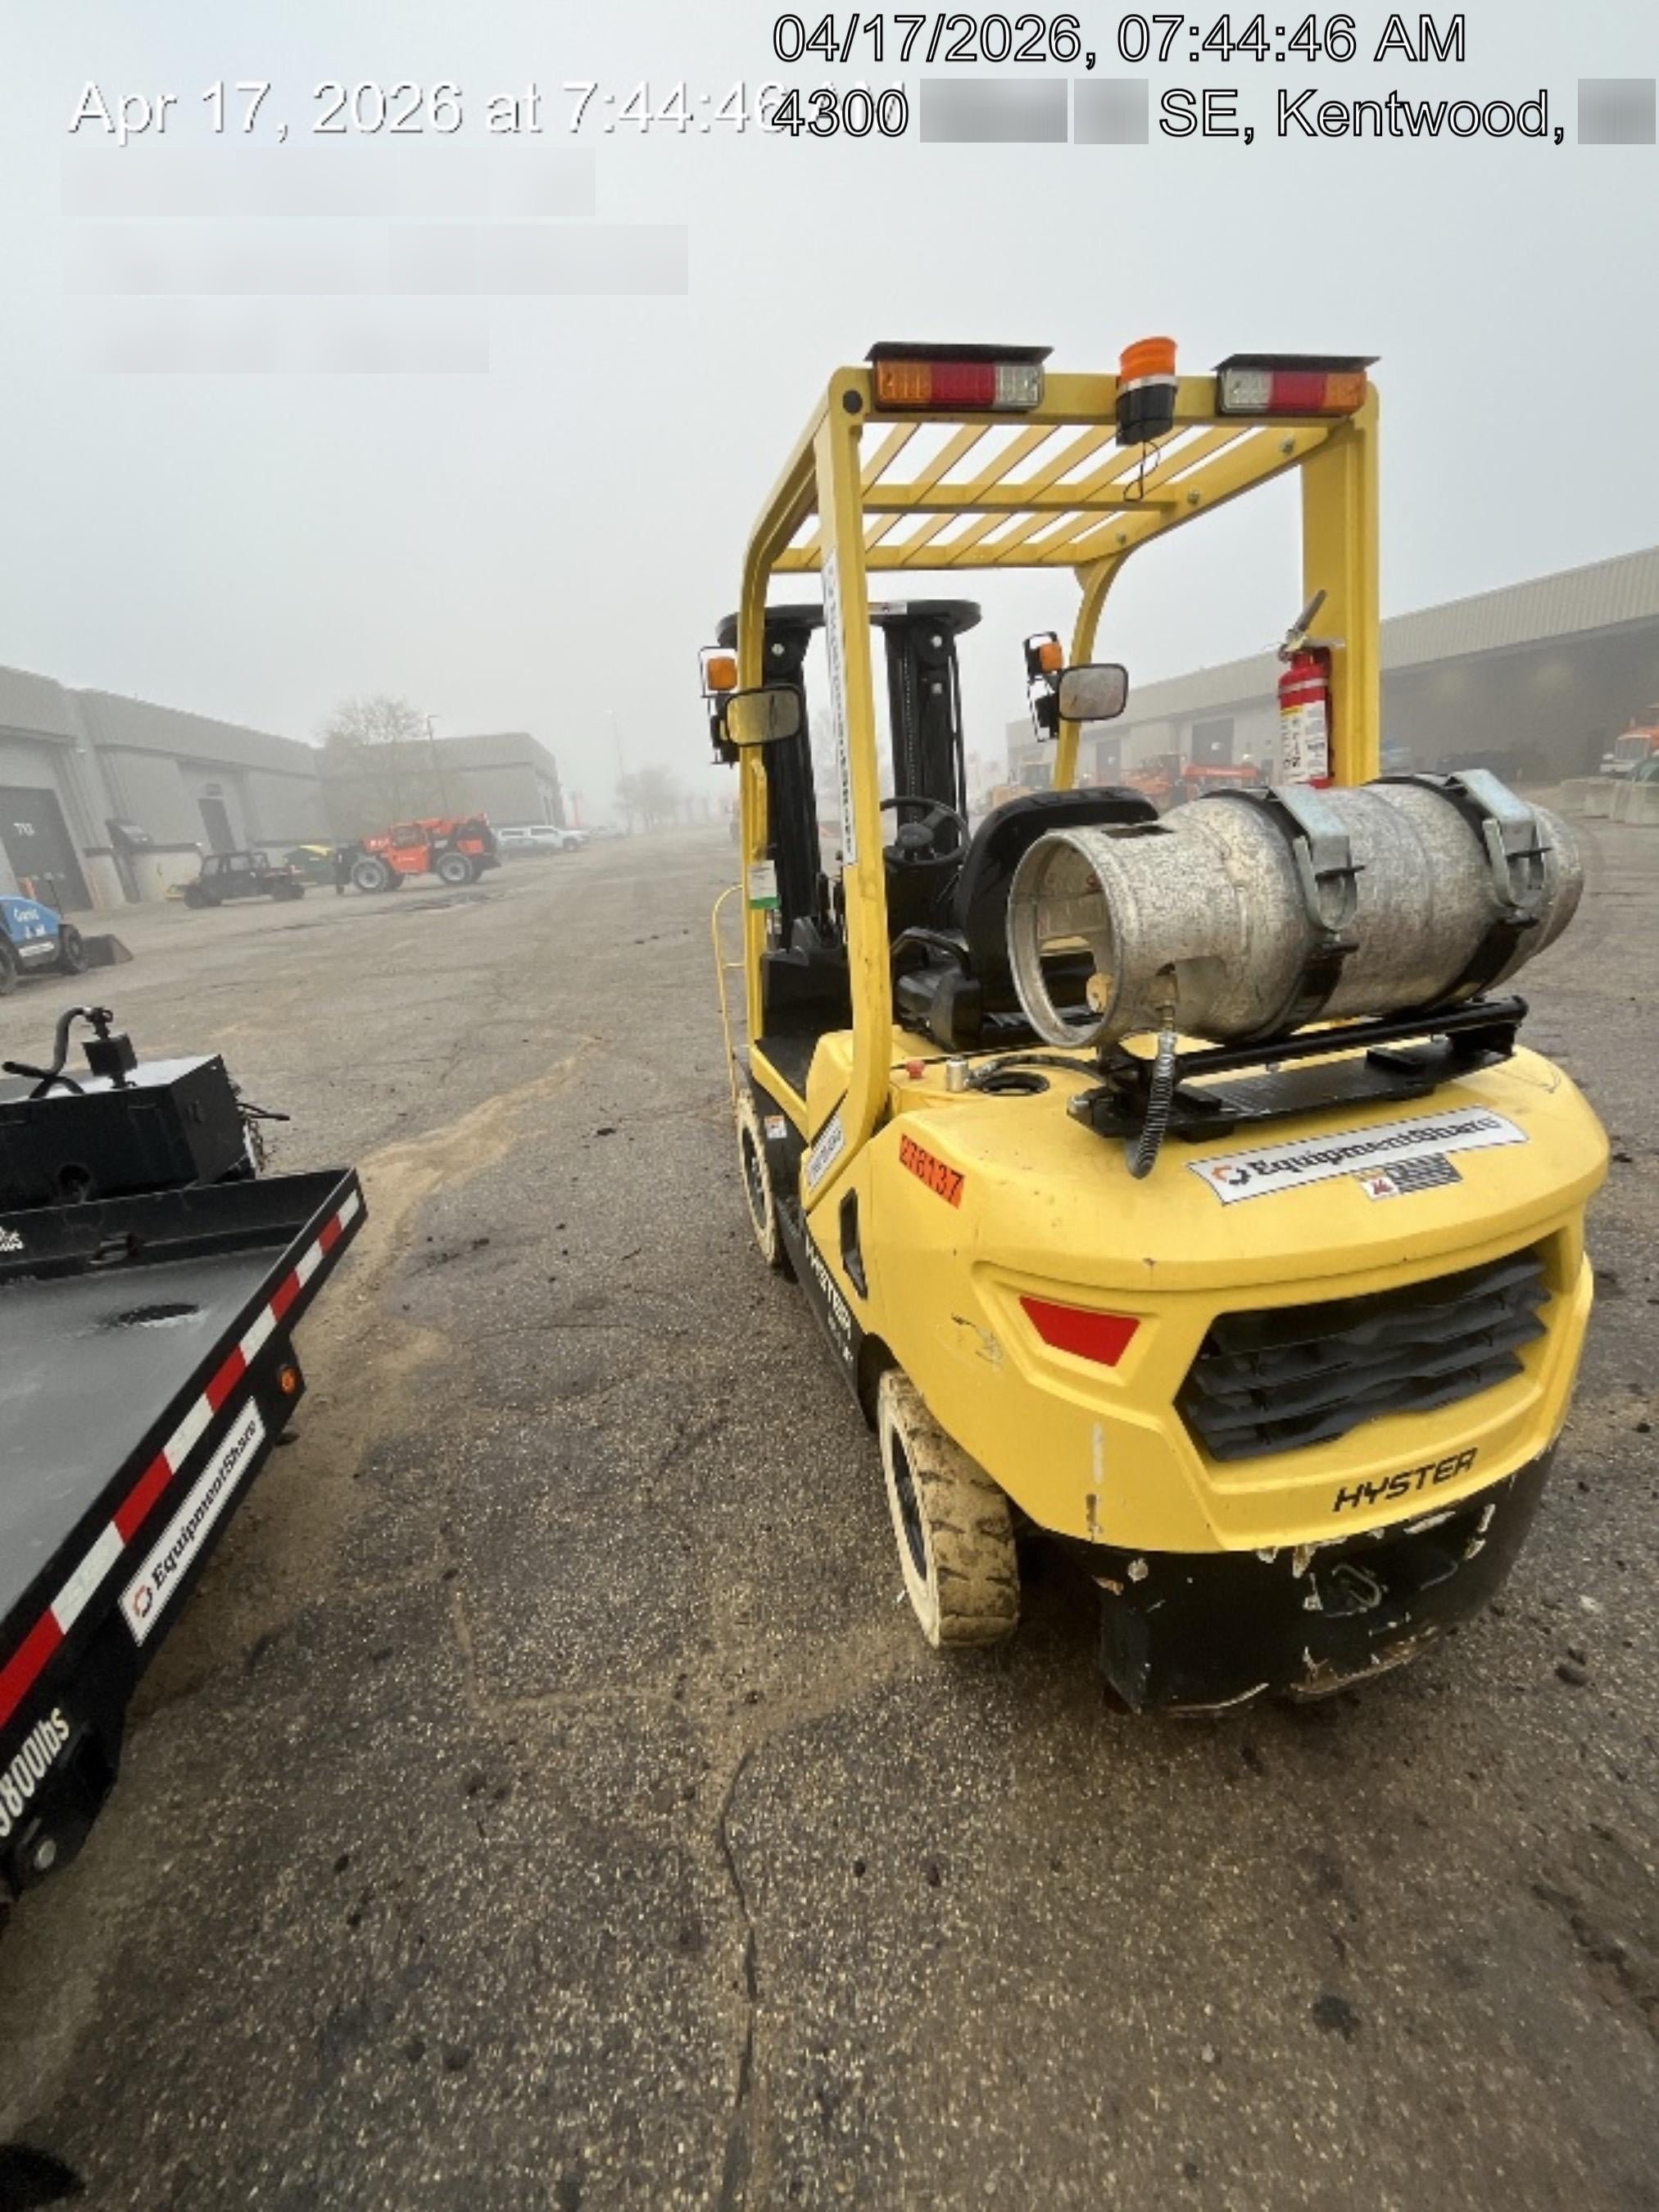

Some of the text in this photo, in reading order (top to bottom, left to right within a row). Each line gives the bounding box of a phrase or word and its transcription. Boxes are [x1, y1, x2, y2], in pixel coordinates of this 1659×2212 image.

[1248, 1115, 1503, 1175] EquipmentShare
[152, 1419, 256, 1590] EquipmentShare
[1332, 1447, 1478, 1512] HYSTER
